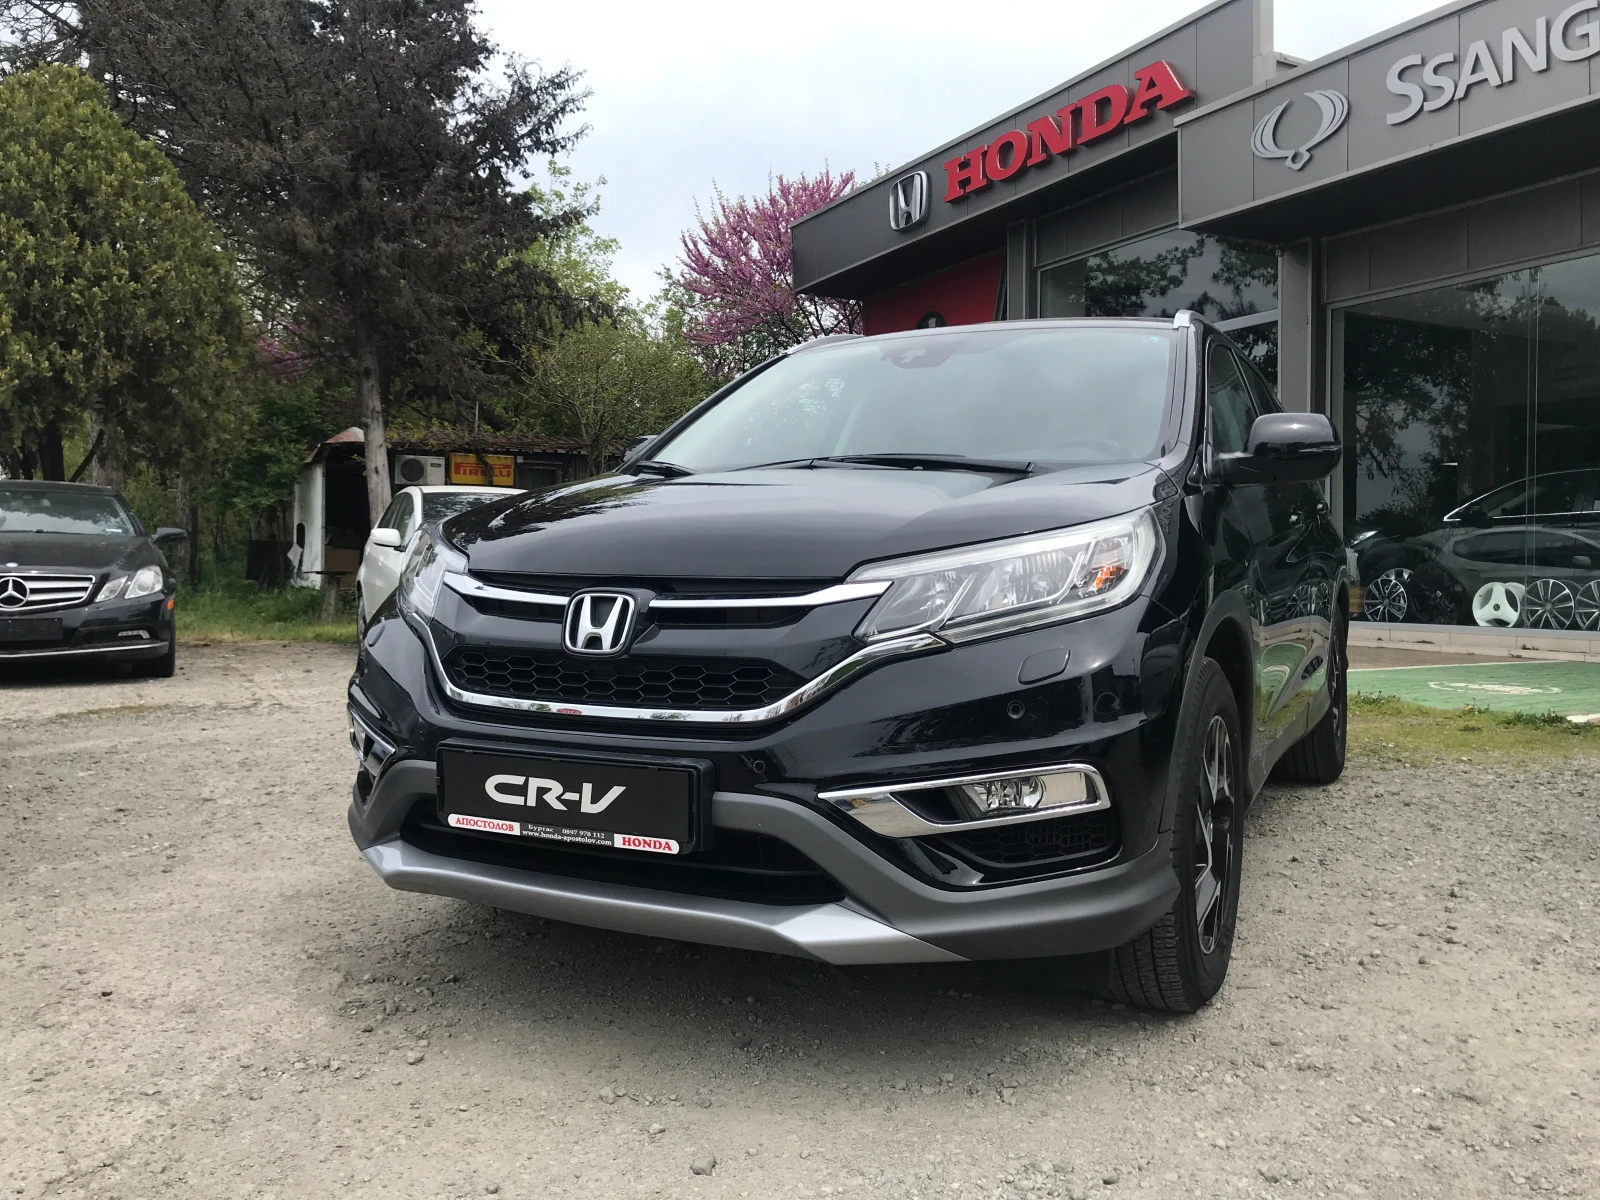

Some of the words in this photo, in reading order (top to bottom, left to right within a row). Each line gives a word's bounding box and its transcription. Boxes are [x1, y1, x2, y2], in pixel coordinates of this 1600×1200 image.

[944, 60, 1195, 203] HONDA
[484, 774, 627, 814] CR-V
[455, 817, 514, 832] АПОСТОЛОВ
[522, 830, 612, 845] www.honda-apostolov.com
[621, 836, 673, 851] HONDA
